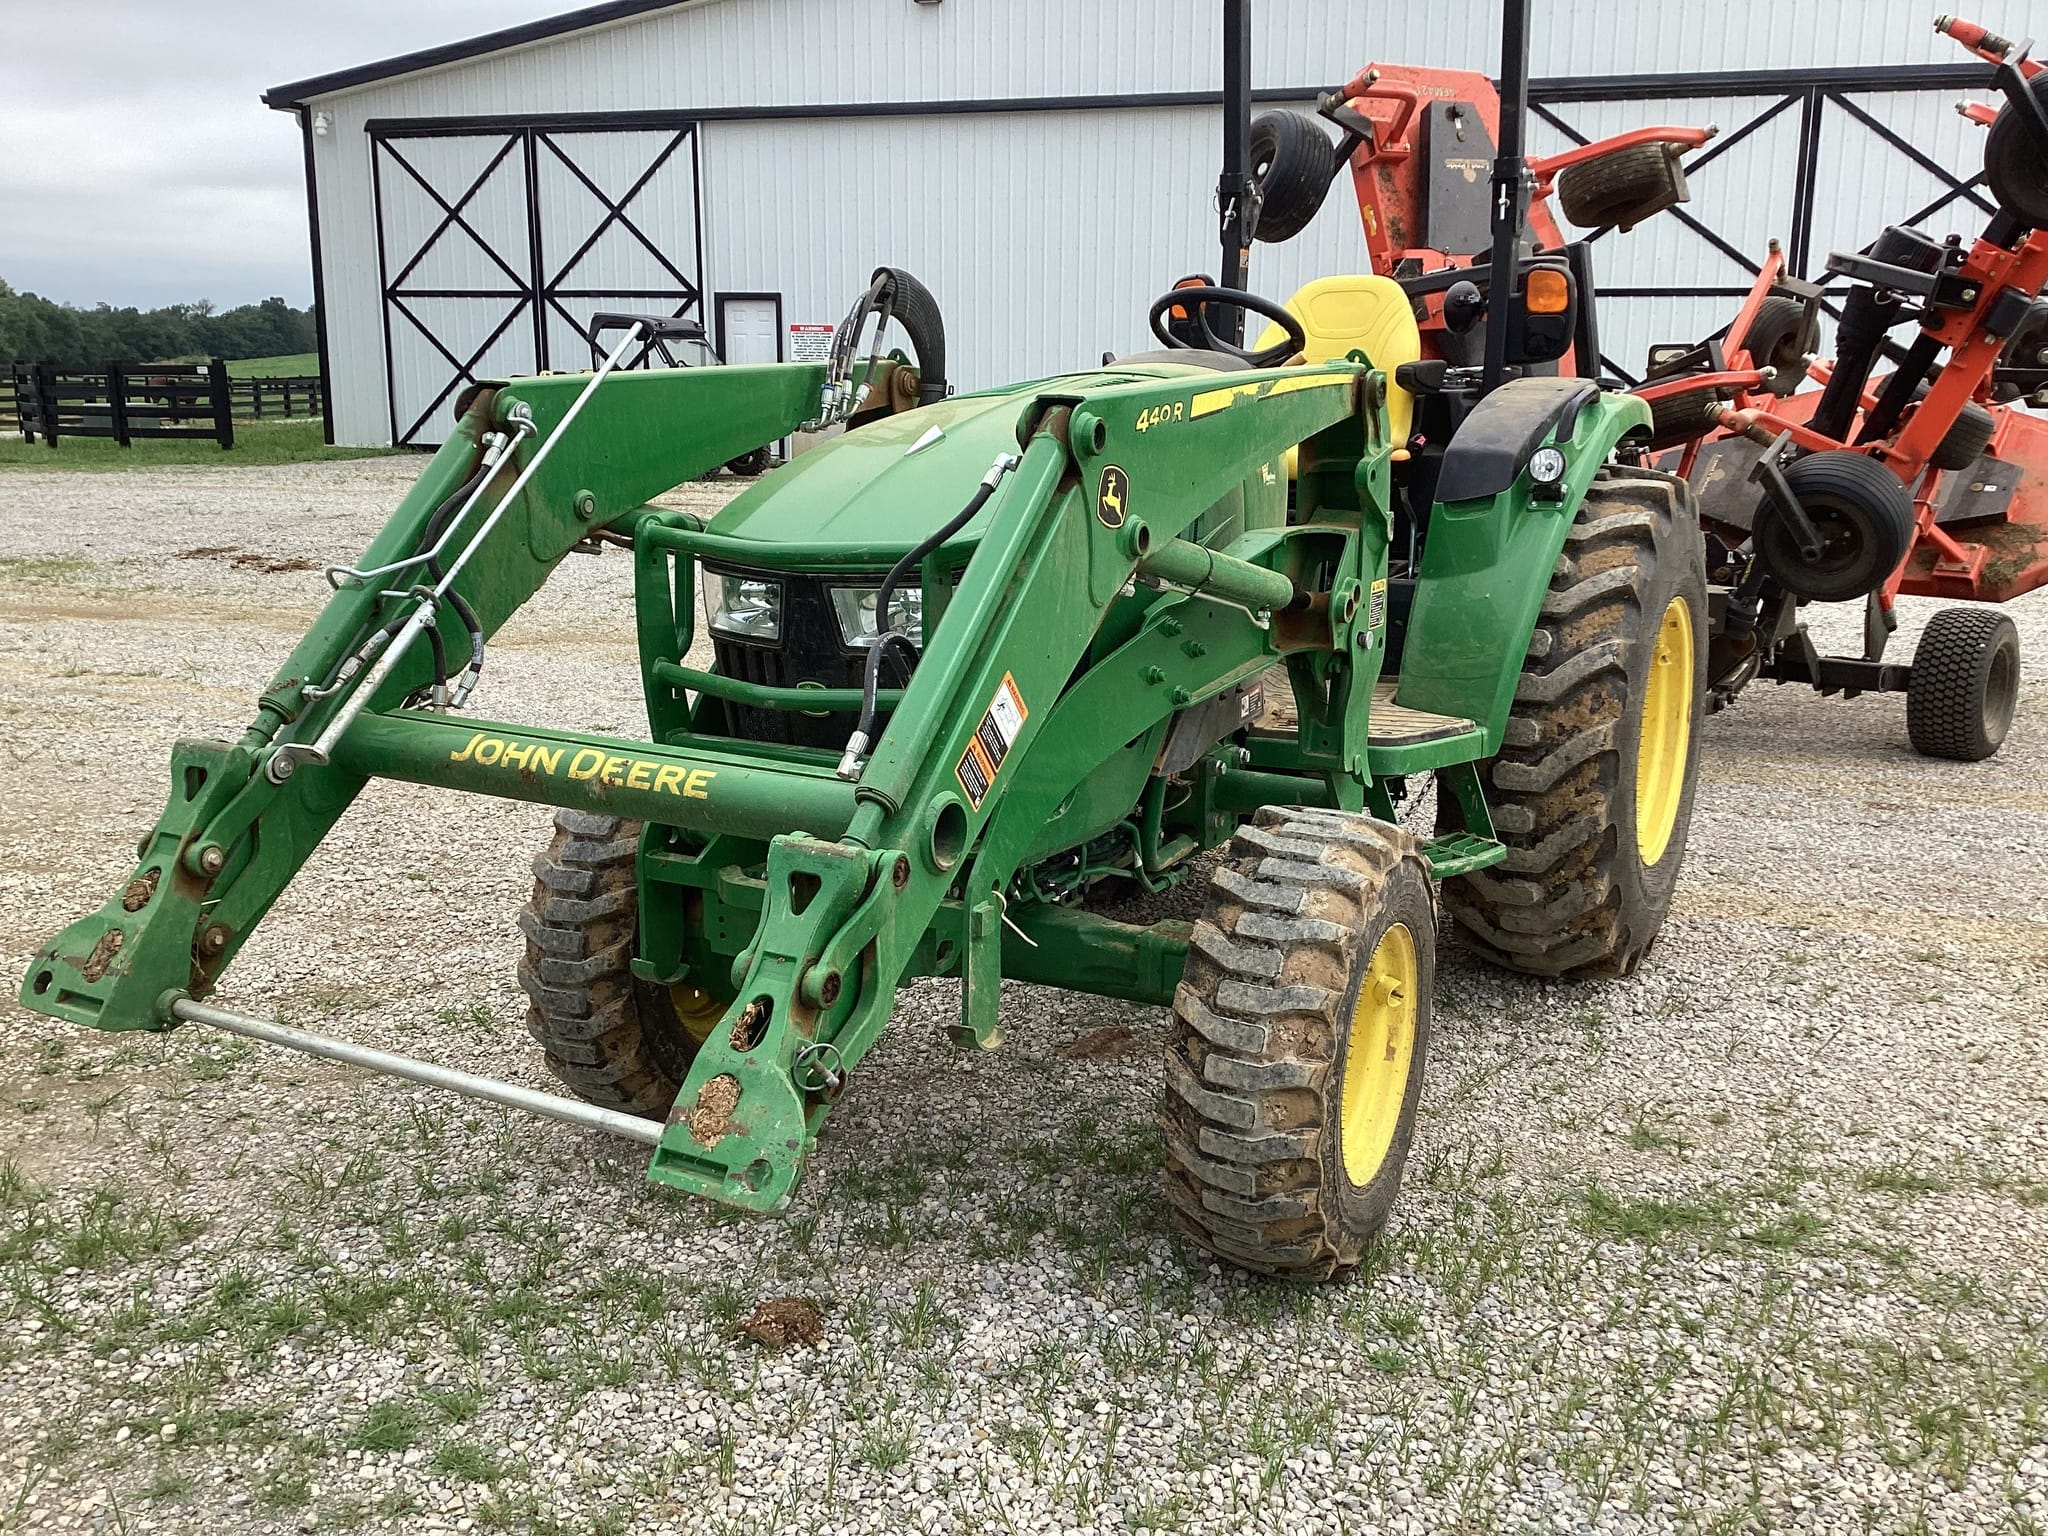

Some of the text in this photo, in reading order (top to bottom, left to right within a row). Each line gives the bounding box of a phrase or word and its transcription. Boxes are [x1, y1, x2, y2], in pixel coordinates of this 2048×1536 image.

[1135, 401, 1184, 433] 440R
[450, 733, 718, 800] JOHN DEERE
